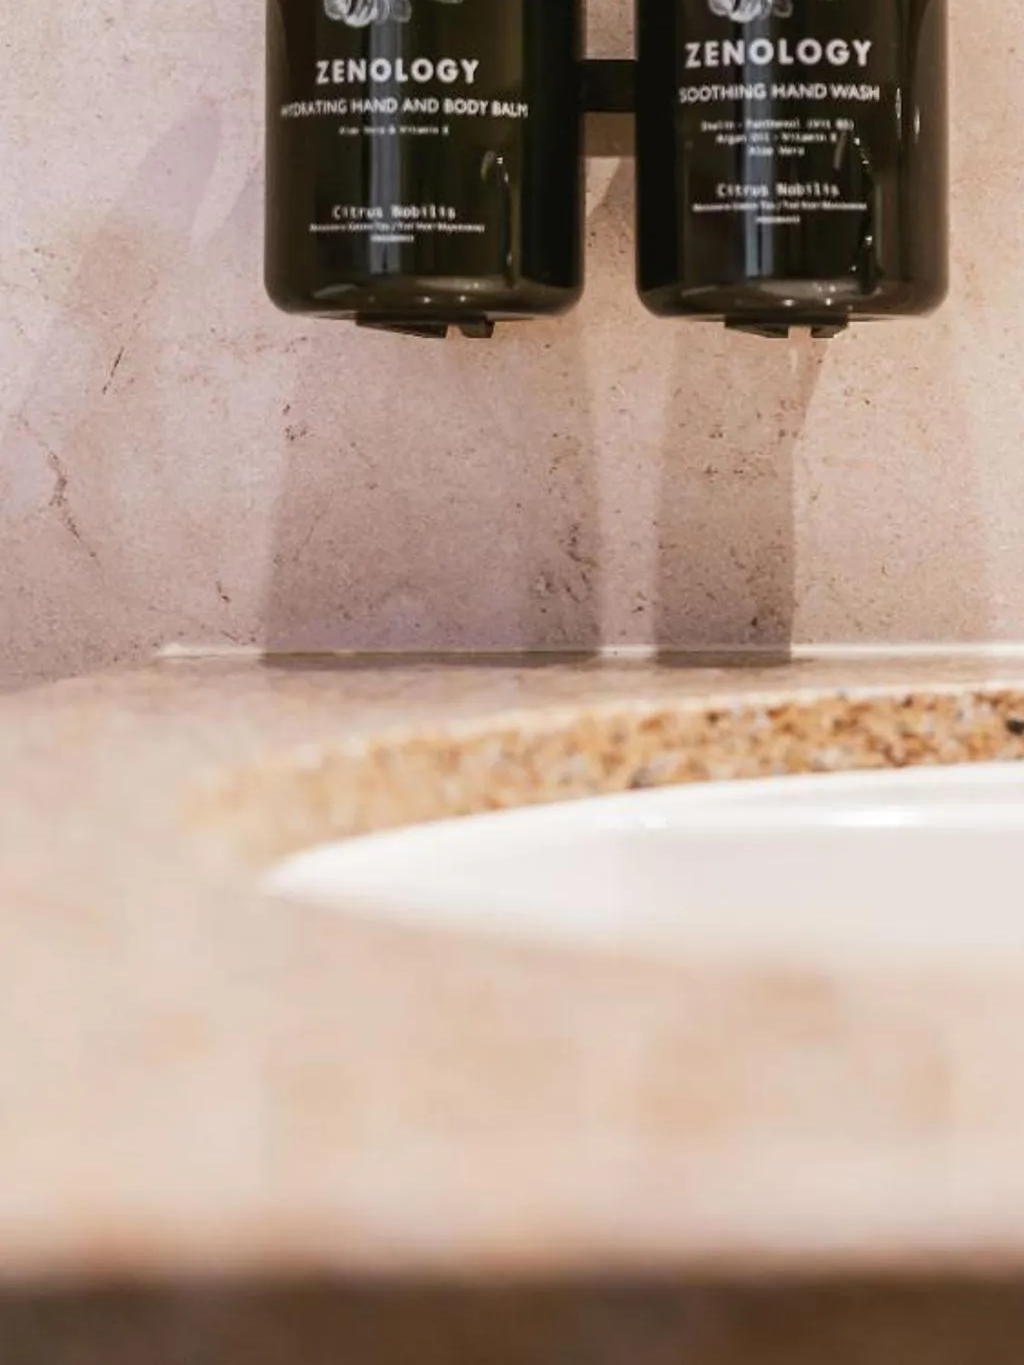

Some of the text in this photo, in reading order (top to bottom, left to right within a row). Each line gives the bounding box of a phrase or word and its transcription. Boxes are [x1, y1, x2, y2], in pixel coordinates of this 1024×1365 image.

[684, 38, 873, 69] ZENOLOGY
[316, 58, 480, 84] ZENOLOGY
[679, 83, 881, 104] SOOTHING HAND WASH
[351, 97, 398, 114] HAND
[402, 97, 440, 114] AND
[444, 97, 488, 115] BODY
[491, 99, 530, 118] BALM
[716, 182, 840, 197] Citrus Nobilis
[332, 204, 457, 220] Citrus Nobilis
